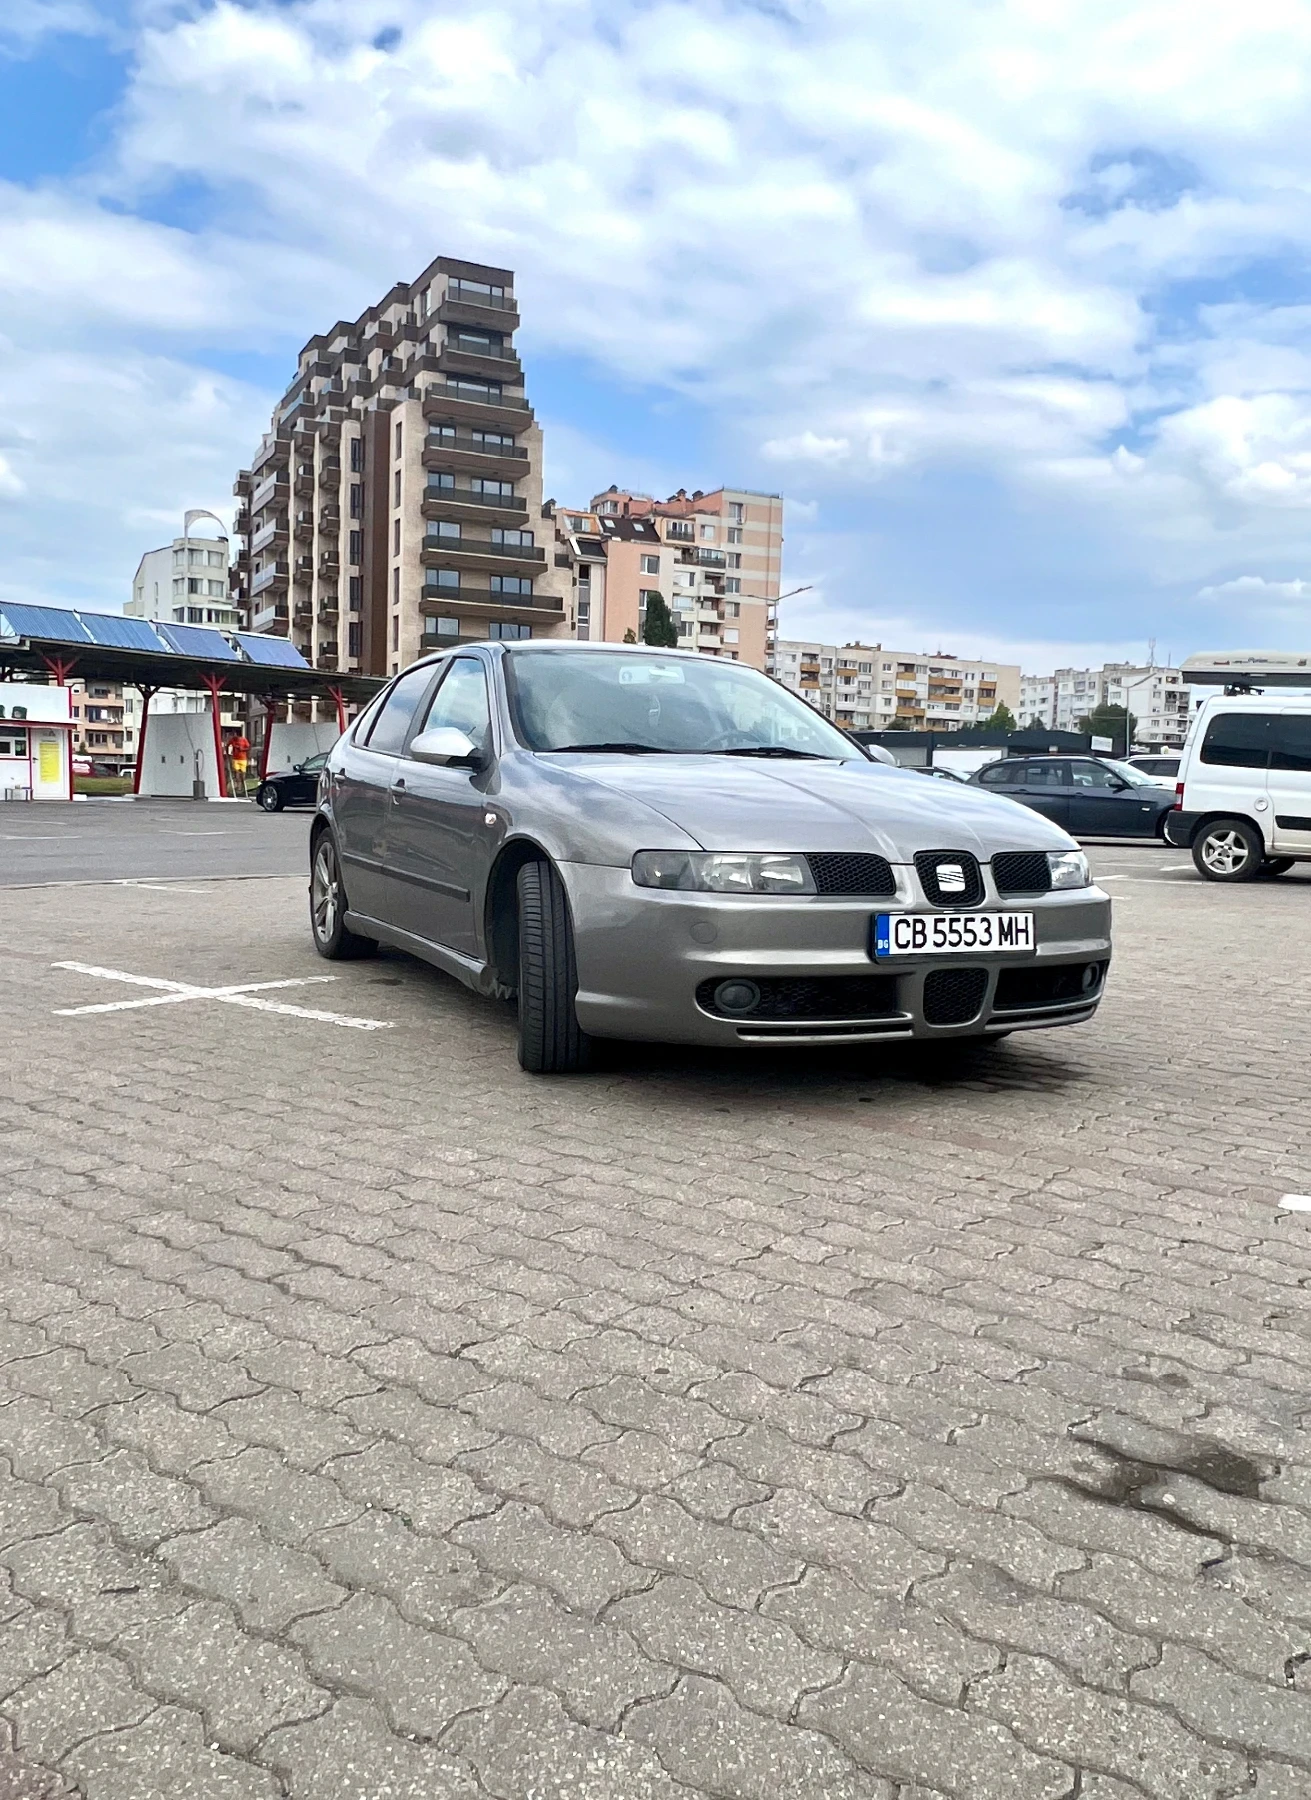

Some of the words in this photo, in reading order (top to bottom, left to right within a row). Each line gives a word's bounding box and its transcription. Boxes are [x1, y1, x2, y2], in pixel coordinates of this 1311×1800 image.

[895, 918, 927, 949] CB
[932, 916, 992, 948] 5553
[998, 916, 1029, 946] MH
[877, 939, 889, 949] BG
